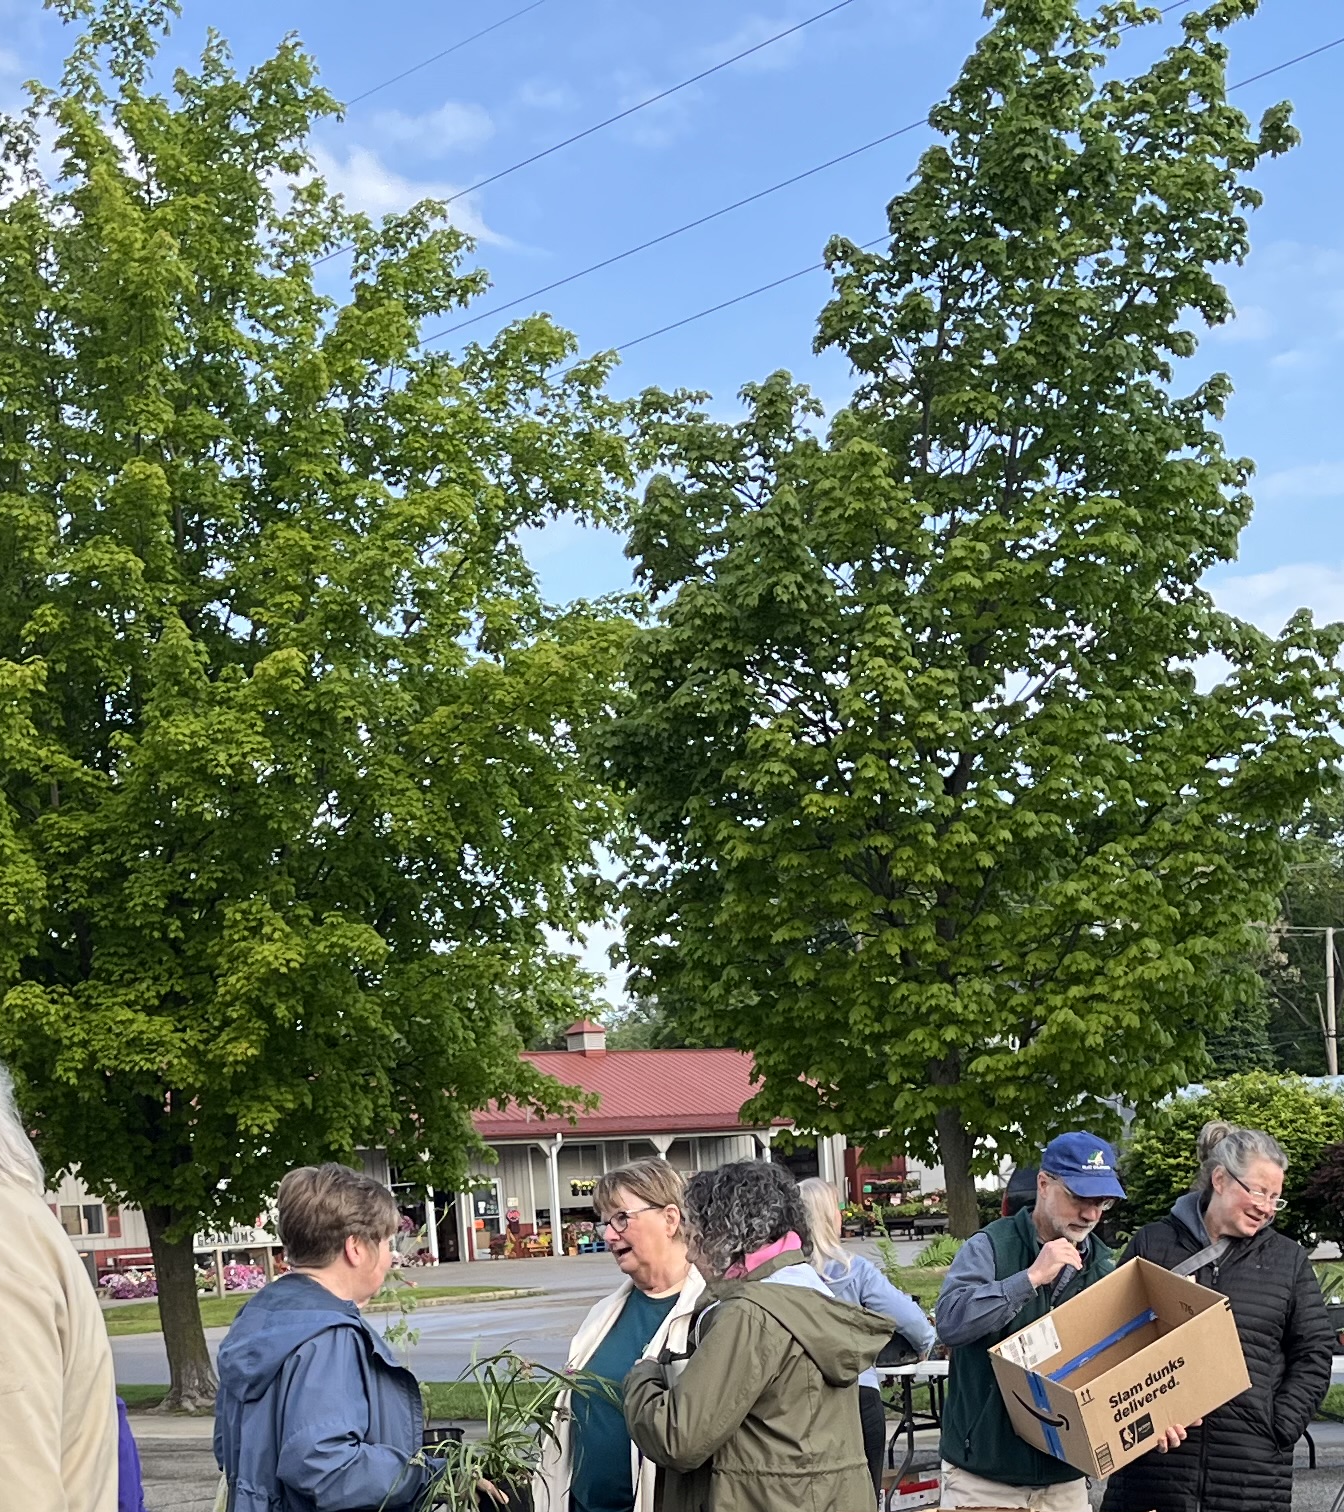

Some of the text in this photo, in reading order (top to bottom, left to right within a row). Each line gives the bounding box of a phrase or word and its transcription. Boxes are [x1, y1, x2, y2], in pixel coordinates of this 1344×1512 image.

[1109, 1356, 1186, 1409] Slam dunks
[1113, 1376, 1181, 1423] delivered.
